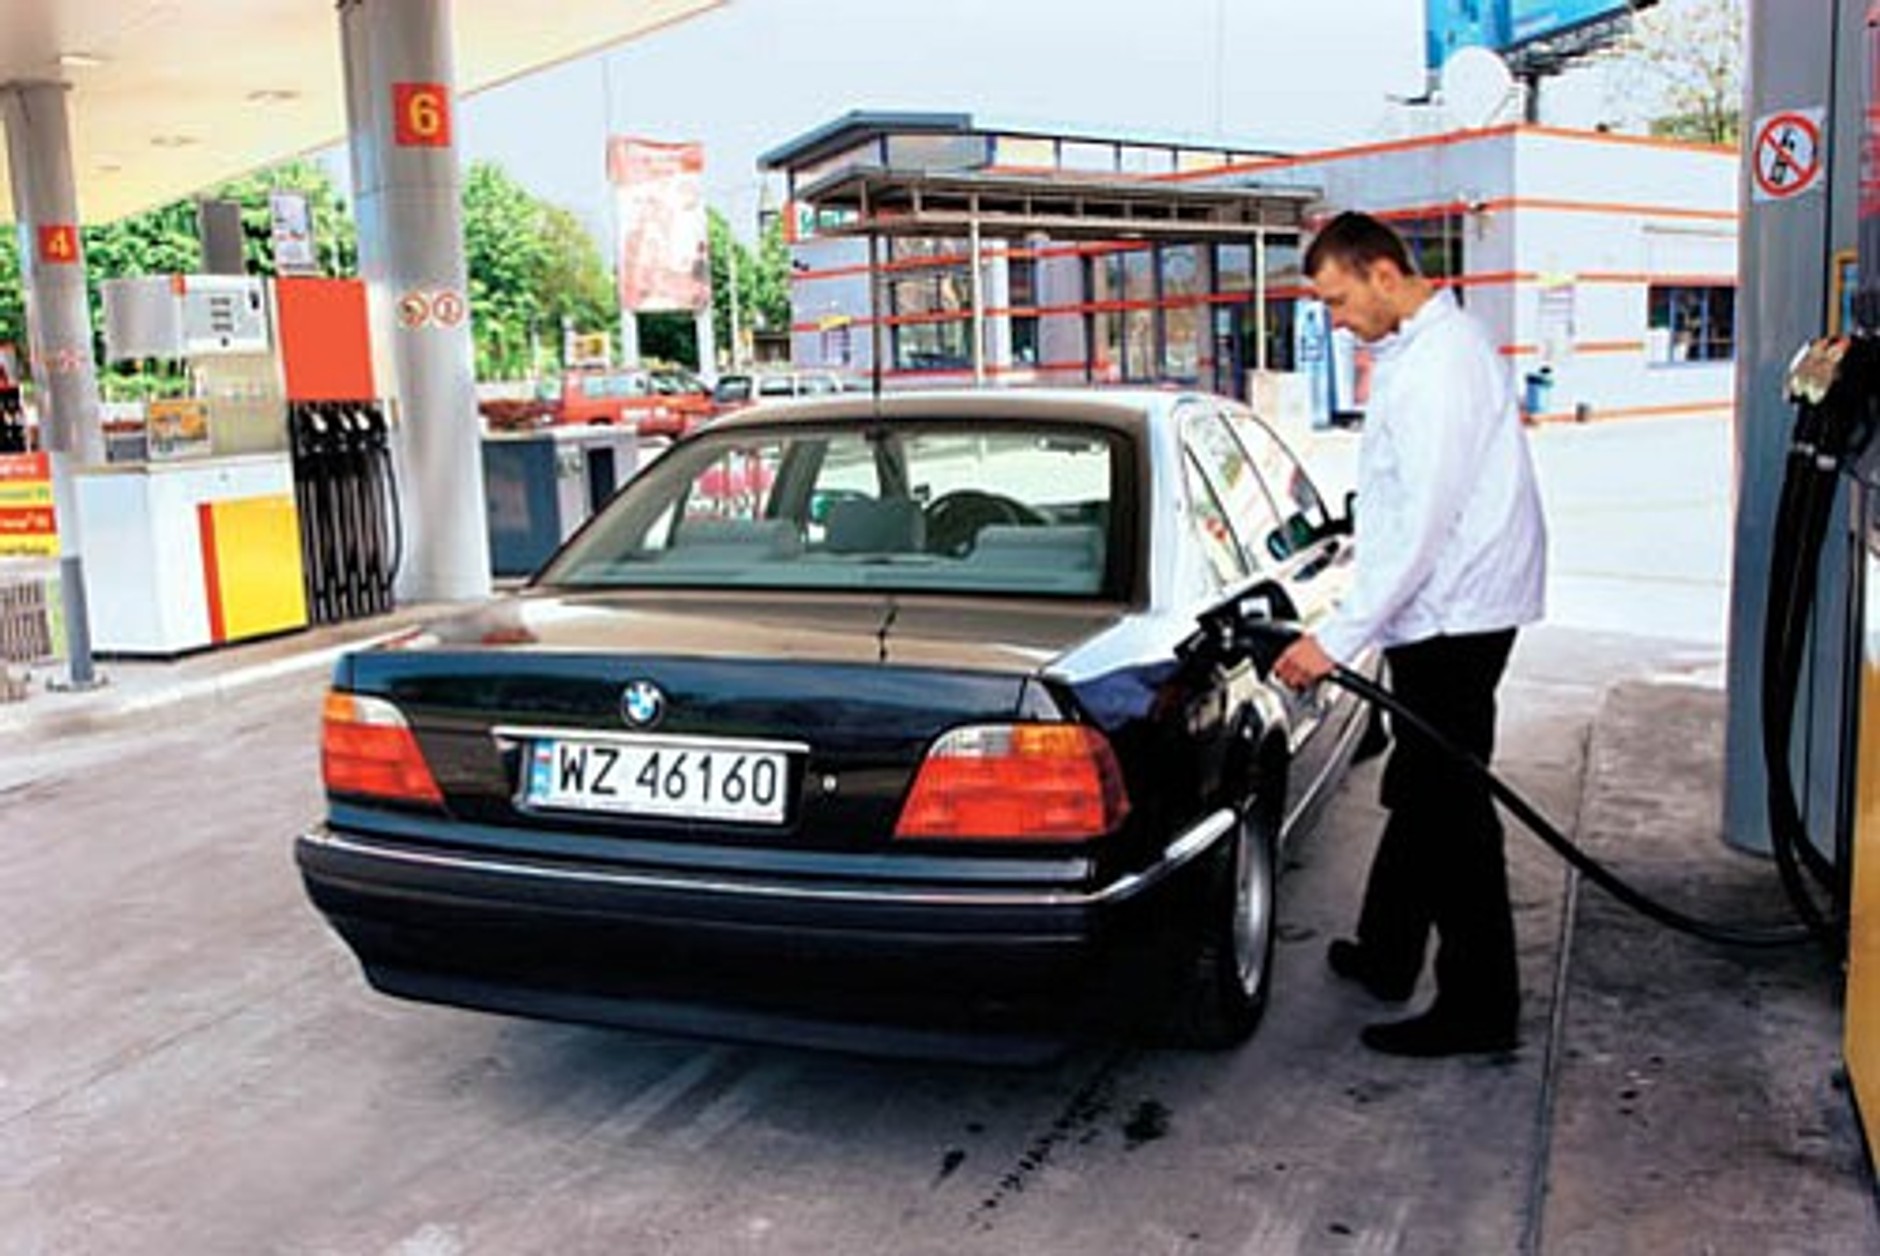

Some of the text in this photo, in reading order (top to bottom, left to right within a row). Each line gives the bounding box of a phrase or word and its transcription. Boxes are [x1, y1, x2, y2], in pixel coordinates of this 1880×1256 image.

[409, 93, 439, 136] 6
[49, 229, 70, 257] 4
[560, 746, 777, 806] WZ 46160
